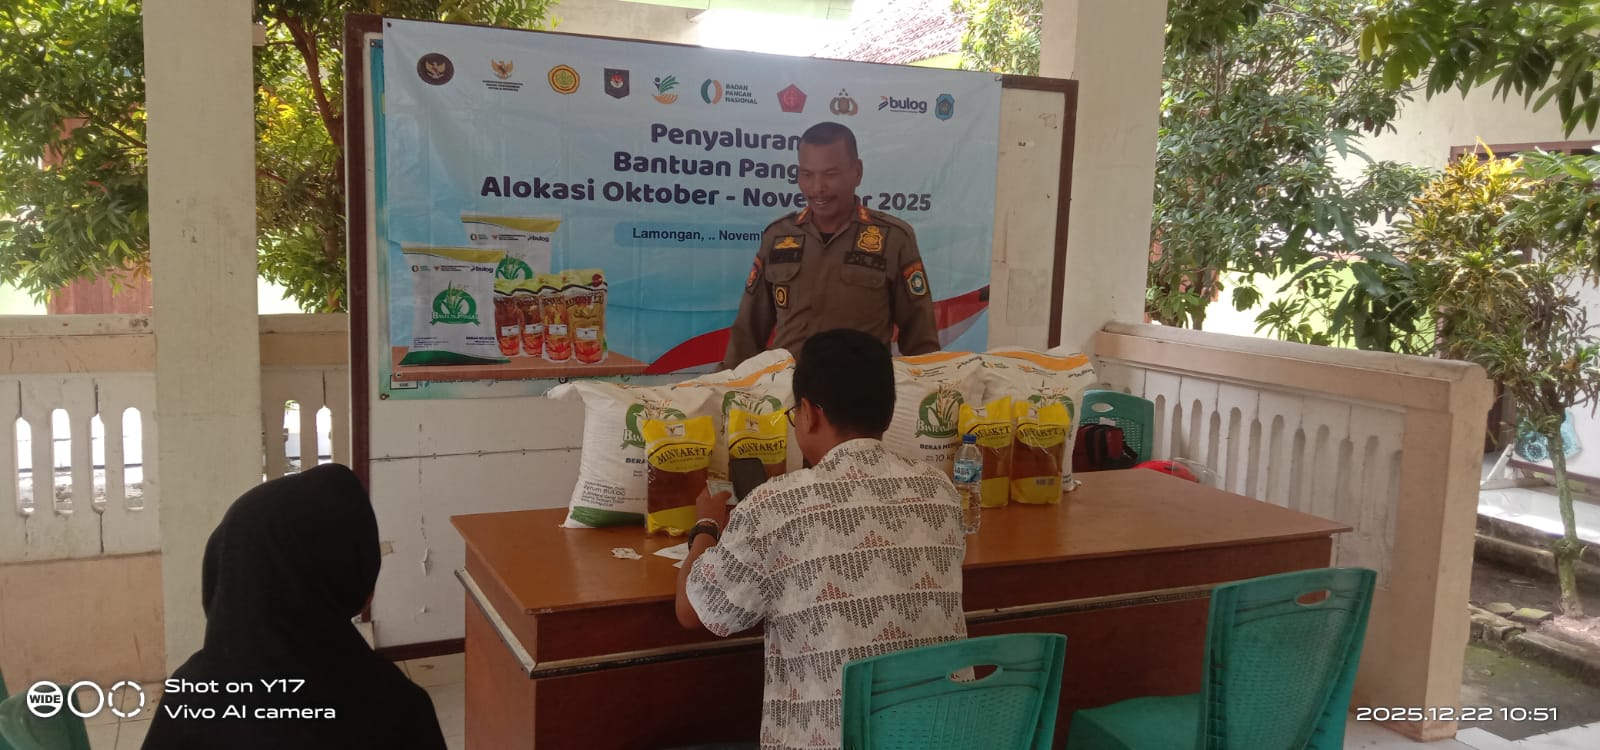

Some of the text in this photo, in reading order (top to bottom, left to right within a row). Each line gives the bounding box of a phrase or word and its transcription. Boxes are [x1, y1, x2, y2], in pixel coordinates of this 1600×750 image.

[725, 83, 748, 91] BADAN
[725, 90, 752, 98] PANGAN
[890, 96, 927, 114] bulog
[651, 123, 801, 151] Penyaluran
[614, 151, 800, 184] Bantuan Pang
[480, 175, 595, 200] Alokasi
[602, 180, 719, 205] Oktober
[878, 193, 931, 211] 2025
[632, 227, 705, 242] Lamongan,
[719, 229, 764, 242] Novem
[656, 447, 713, 465] MINYAKITA
[935, 454, 945, 462] 10
